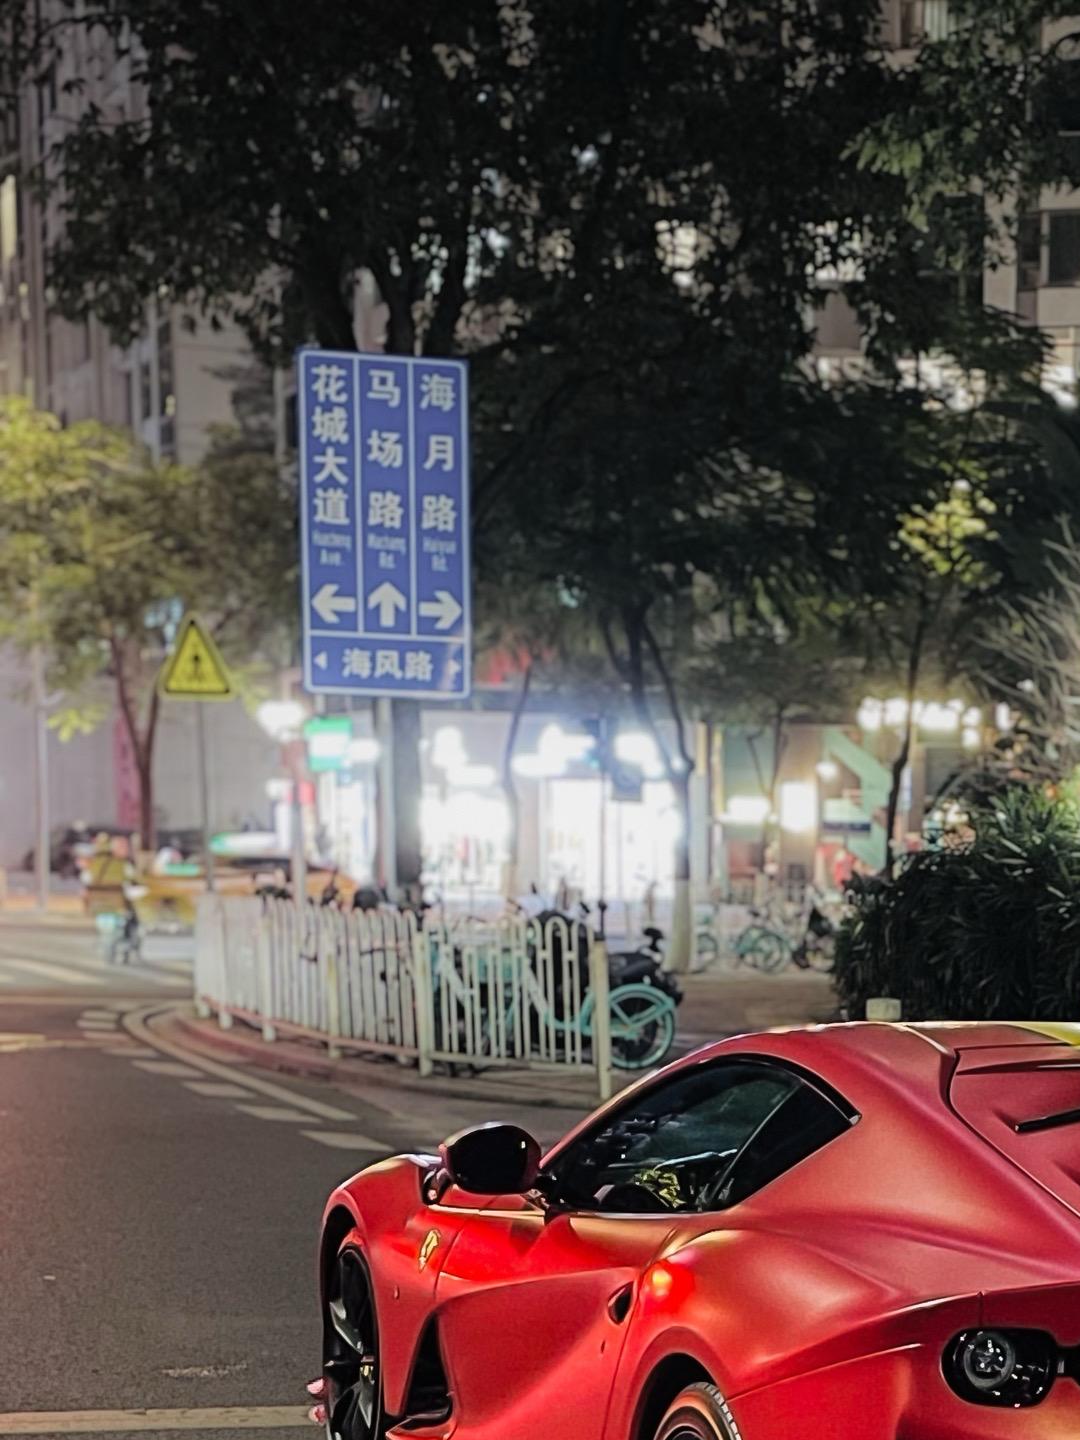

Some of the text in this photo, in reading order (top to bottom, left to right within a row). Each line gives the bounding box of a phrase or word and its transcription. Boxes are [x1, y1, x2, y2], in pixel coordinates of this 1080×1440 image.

[311, 364, 350, 525] 花城大道
[366, 369, 405, 530] 马场路
[419, 374, 458, 532] 海月路
[342, 647, 433, 682] 海风路
